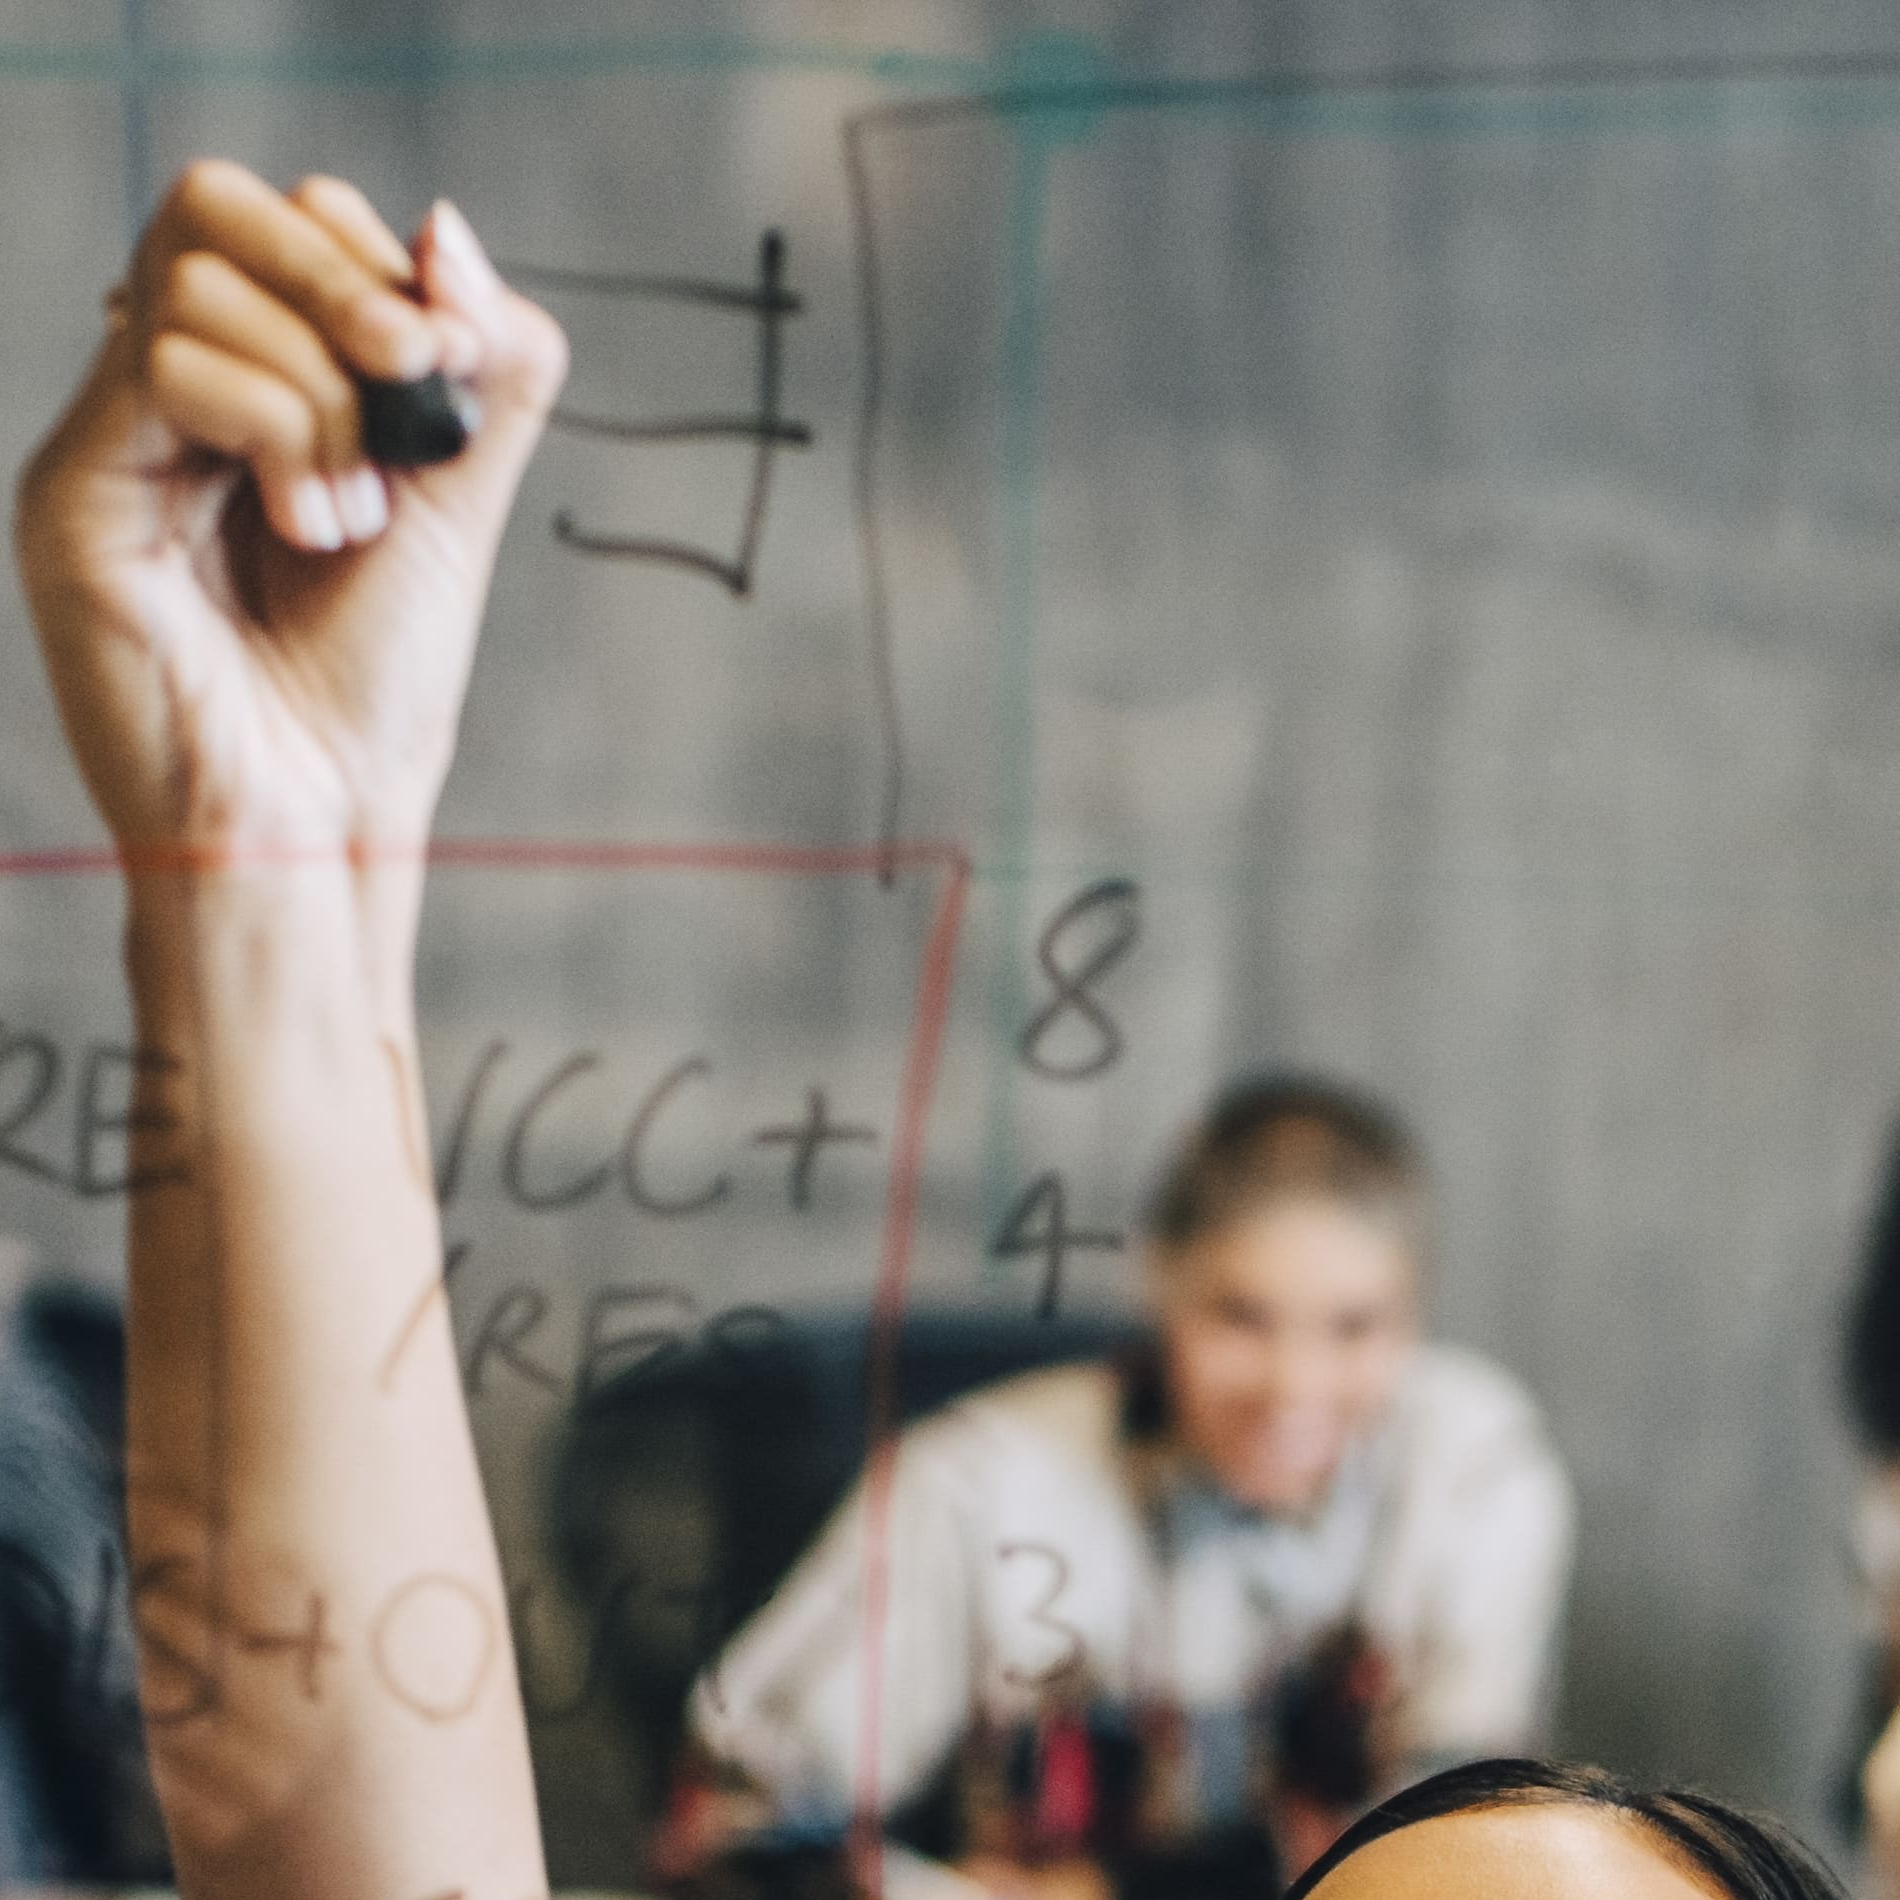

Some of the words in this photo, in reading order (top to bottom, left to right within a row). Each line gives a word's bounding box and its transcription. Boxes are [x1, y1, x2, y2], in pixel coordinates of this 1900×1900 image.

[1020, 880, 1142, 1080] 8
[993, 1168, 1128, 1322] 4
[995, 1543, 1084, 1687] 3
